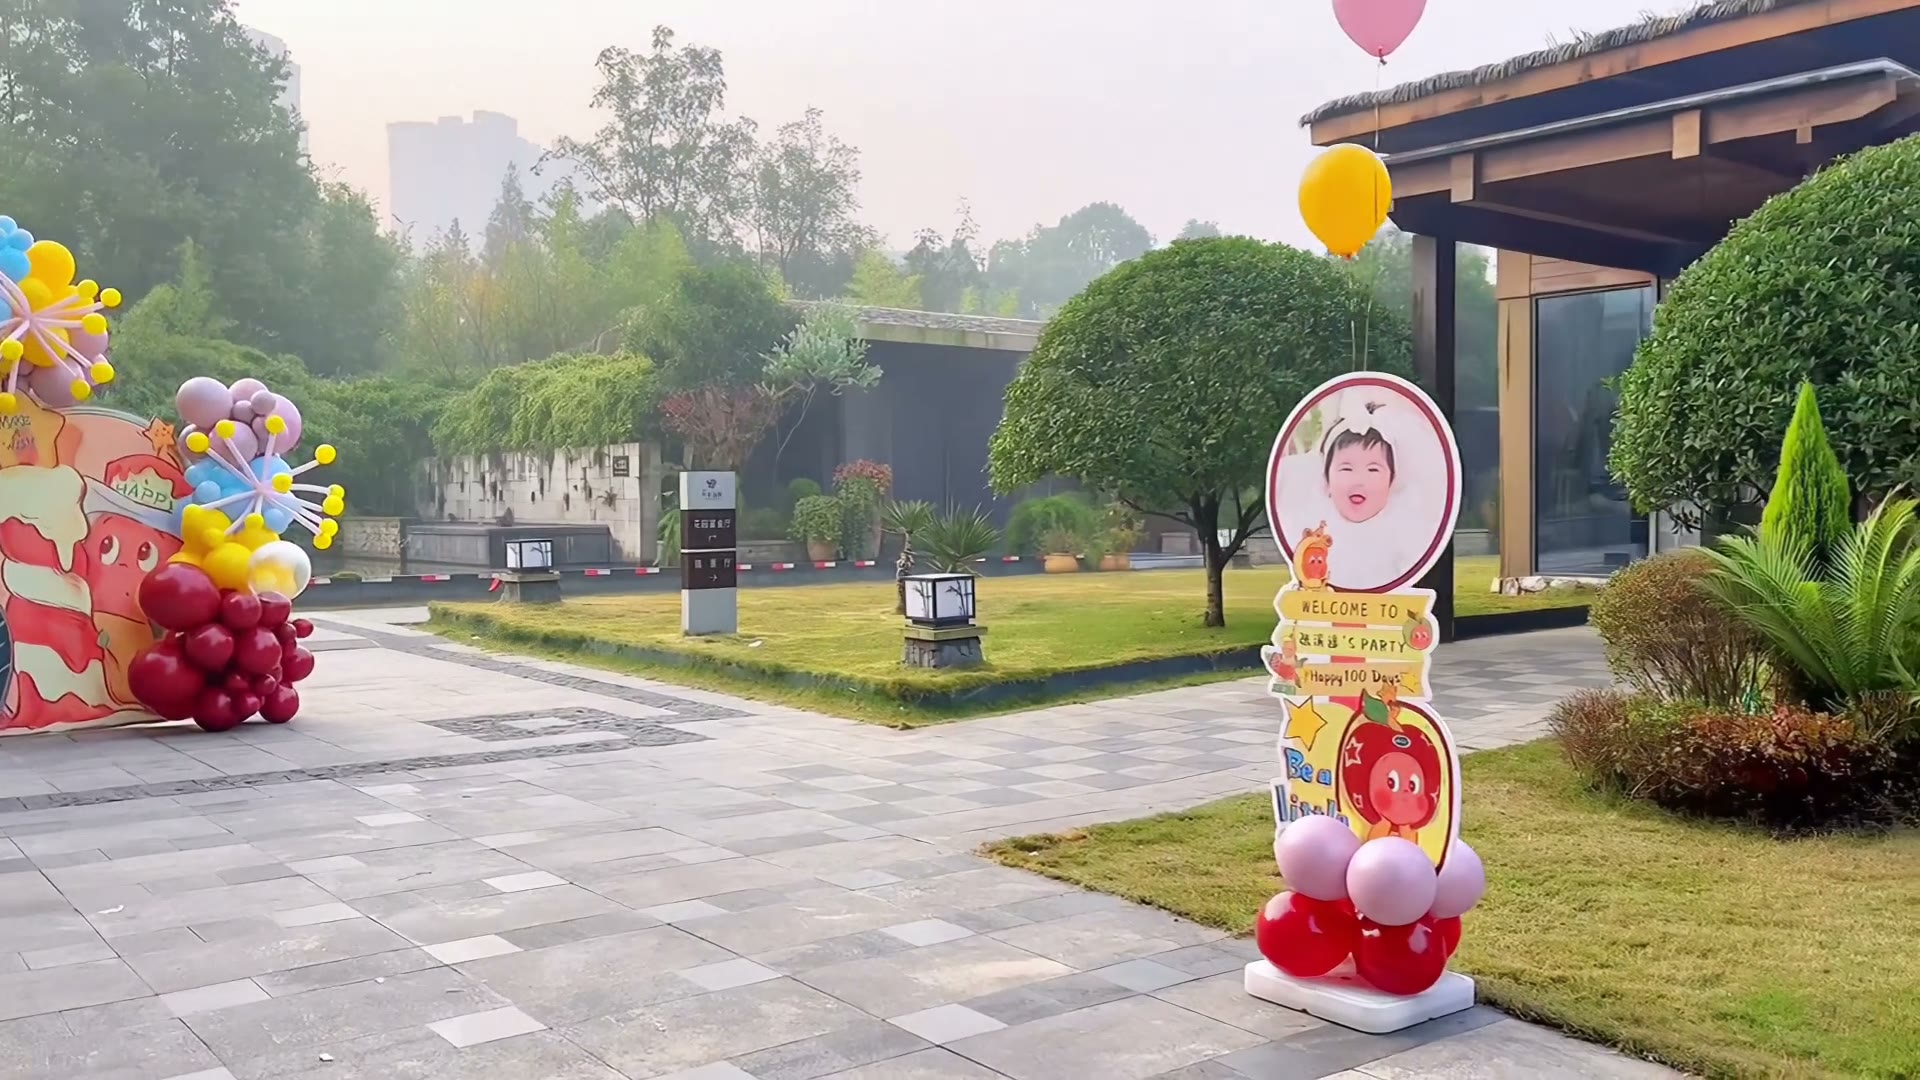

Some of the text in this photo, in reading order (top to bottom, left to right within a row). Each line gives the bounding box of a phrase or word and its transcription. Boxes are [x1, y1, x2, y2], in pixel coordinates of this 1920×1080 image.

[1302, 599, 1398, 619] WELCOME TO
[1361, 638, 1407, 653] PARTY
[1371, 669, 1401, 685] Days
[1284, 747, 1332, 786] Be a
